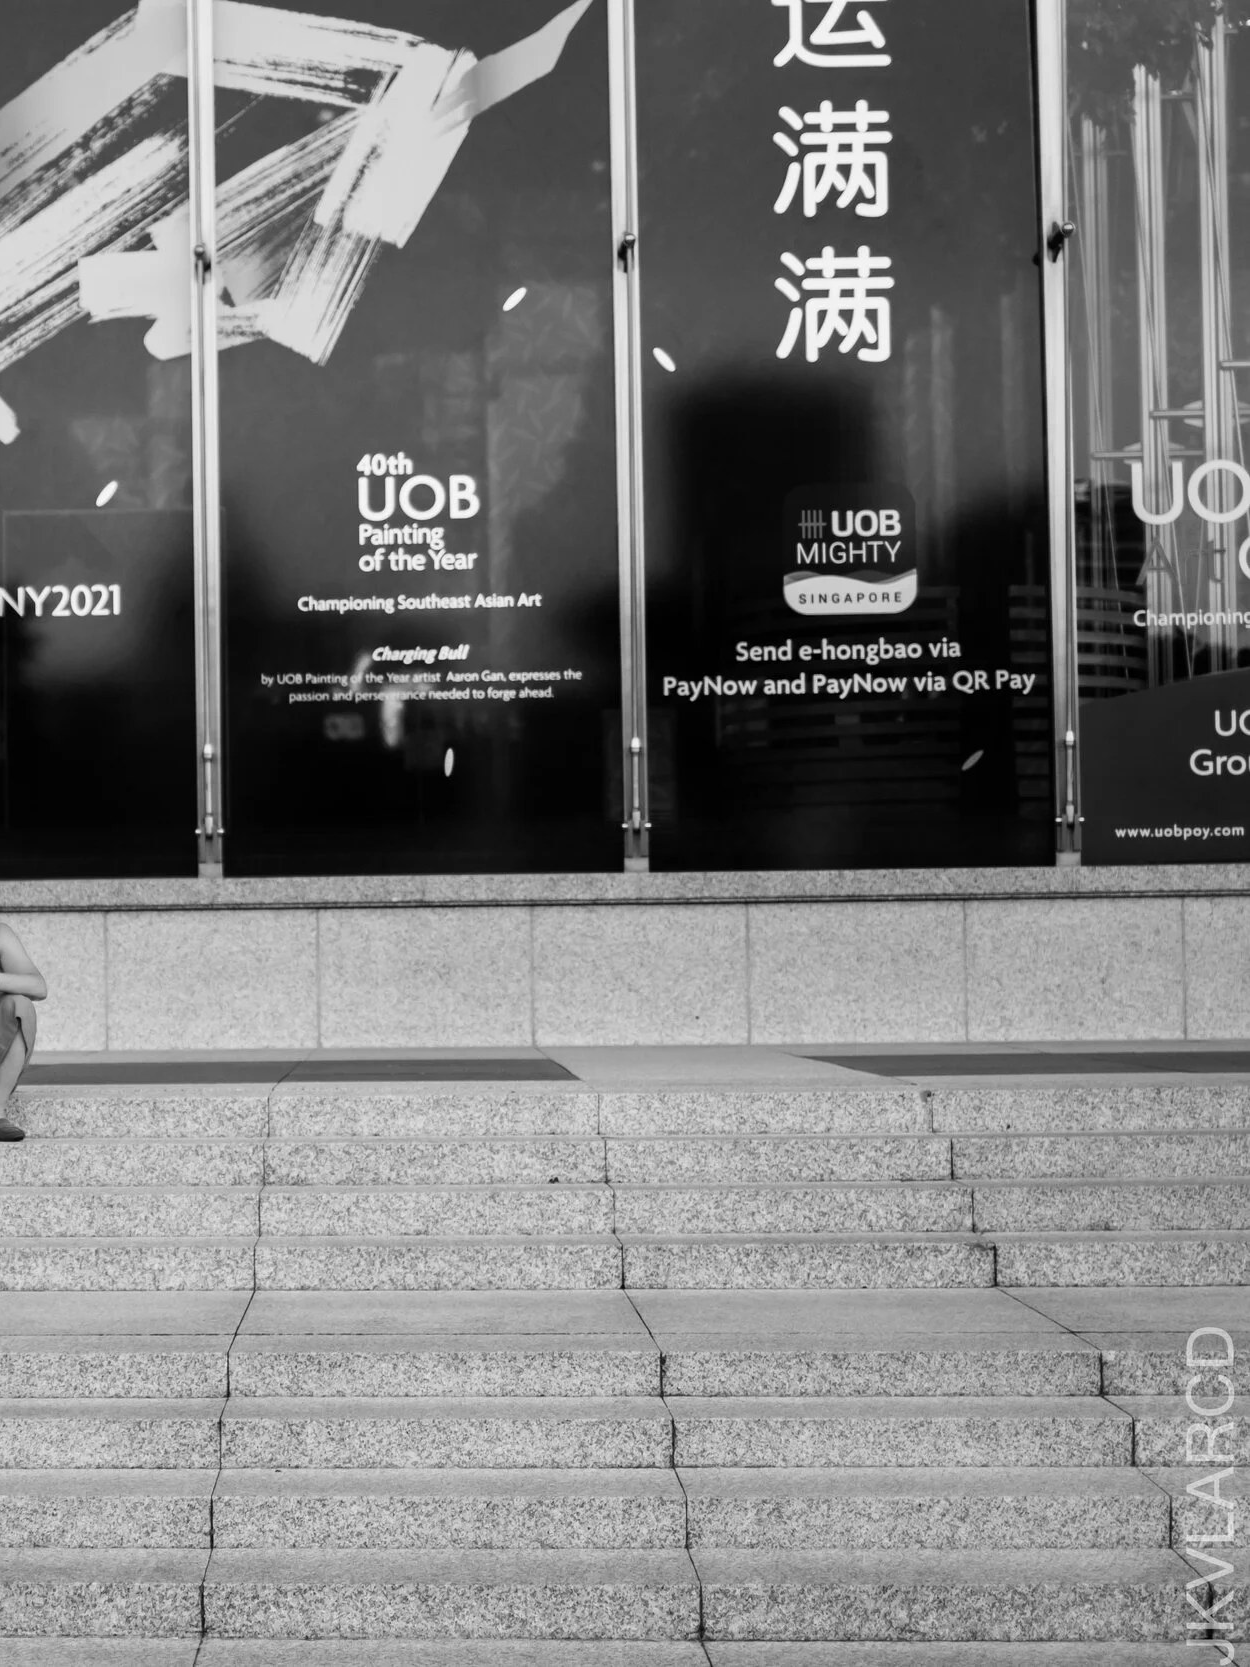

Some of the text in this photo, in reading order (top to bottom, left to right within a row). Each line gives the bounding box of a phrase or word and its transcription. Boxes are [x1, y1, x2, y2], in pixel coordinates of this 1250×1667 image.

[356, 451, 413, 476] 40th
[358, 474, 480, 521] UOB
[831, 509, 902, 538] UOB
[358, 523, 445, 550] Painting
[358, 547, 478, 572] of the Year
[796, 541, 902, 564] MIGHTY
[297, 593, 542, 614] Championing Southeast Asian Art
[798, 592, 902, 604] SINGAPORE
[372, 644, 470, 665] Charging Bull
[735, 637, 962, 665] Send e-hongbao via
[261, 673, 274, 687] by
[276, 673, 303, 685] UOB
[305, 672, 348, 687] Painting
[365, 672, 384, 684] the
[386, 672, 410, 683] Year
[412, 671, 441, 683] artist
[446, 671, 479, 682] Aaron
[508, 671, 561, 683] expresses
[563, 668, 583, 680] the
[662, 669, 1036, 702] PayNow and PayNow via QR Pay
[289, 686, 554, 704] passion and perseance needed to forge ahead.
[1189, 748, 1250, 776] Gro
[1115, 824, 1245, 841] www.uobpoy.com
